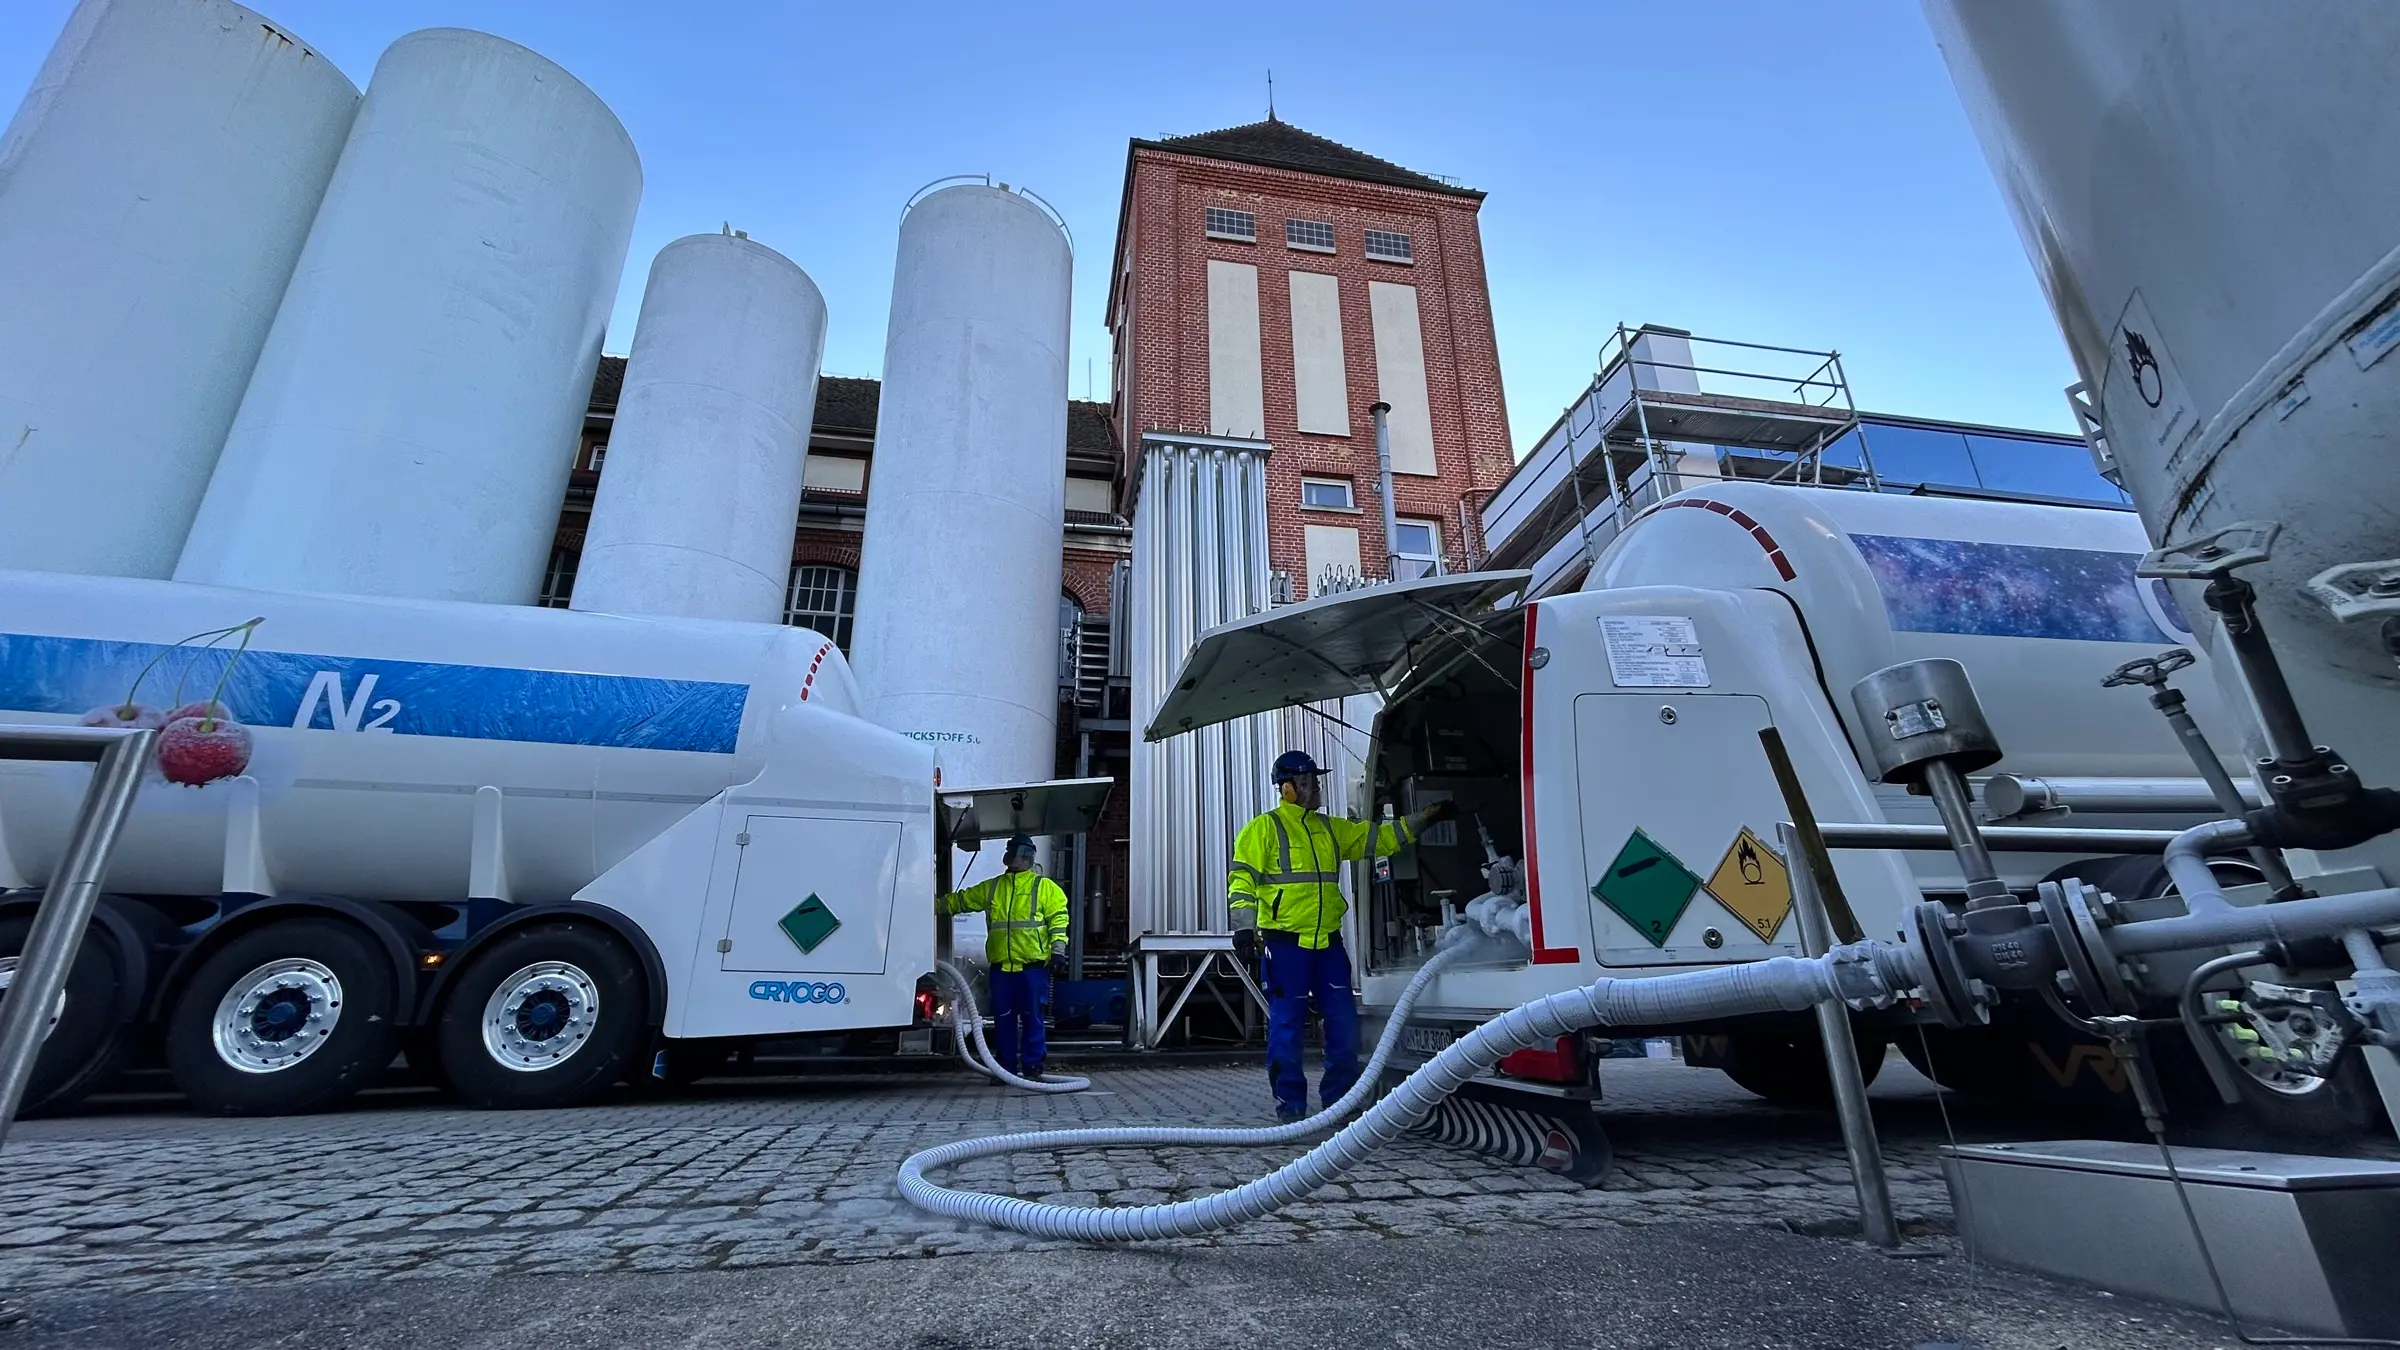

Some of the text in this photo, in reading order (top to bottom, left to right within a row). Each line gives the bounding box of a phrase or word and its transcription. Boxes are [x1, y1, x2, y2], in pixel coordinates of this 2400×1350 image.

[899, 732, 964, 742] TICKSTOFF
[1651, 920, 1662, 933] 2
[1757, 918, 1771, 929] 5.1
